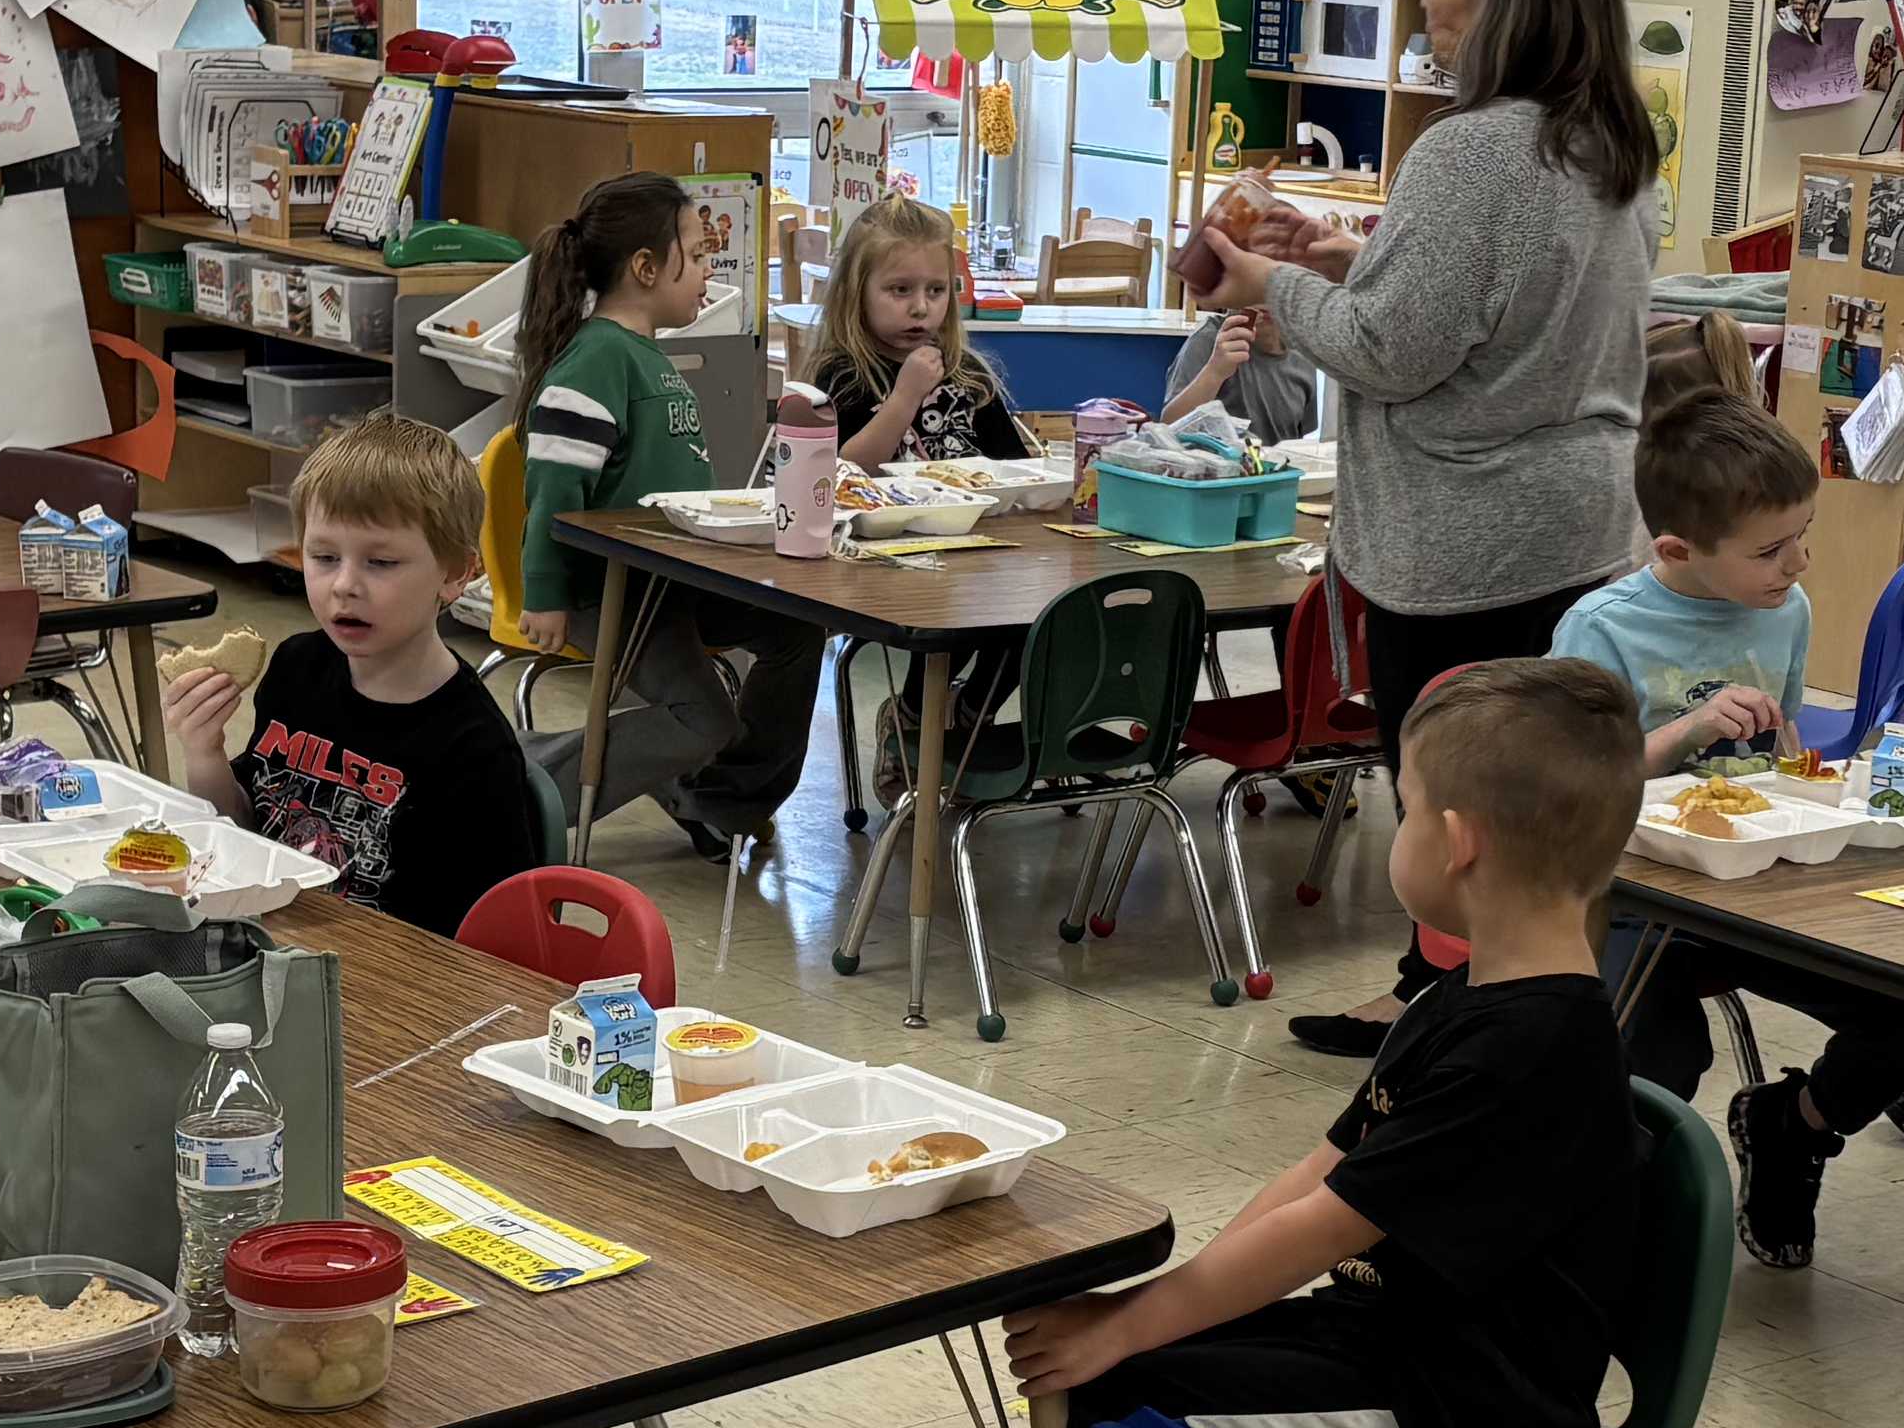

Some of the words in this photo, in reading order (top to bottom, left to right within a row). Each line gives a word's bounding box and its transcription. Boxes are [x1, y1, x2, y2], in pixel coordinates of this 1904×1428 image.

[360, 149, 371, 162] Art
[372, 152, 393, 165] Center
[845, 178, 873, 204] OPEN
[254, 719, 403, 807] MILES
[614, 1030, 633, 1045] 1%
[484, 1214, 530, 1238] Levi
